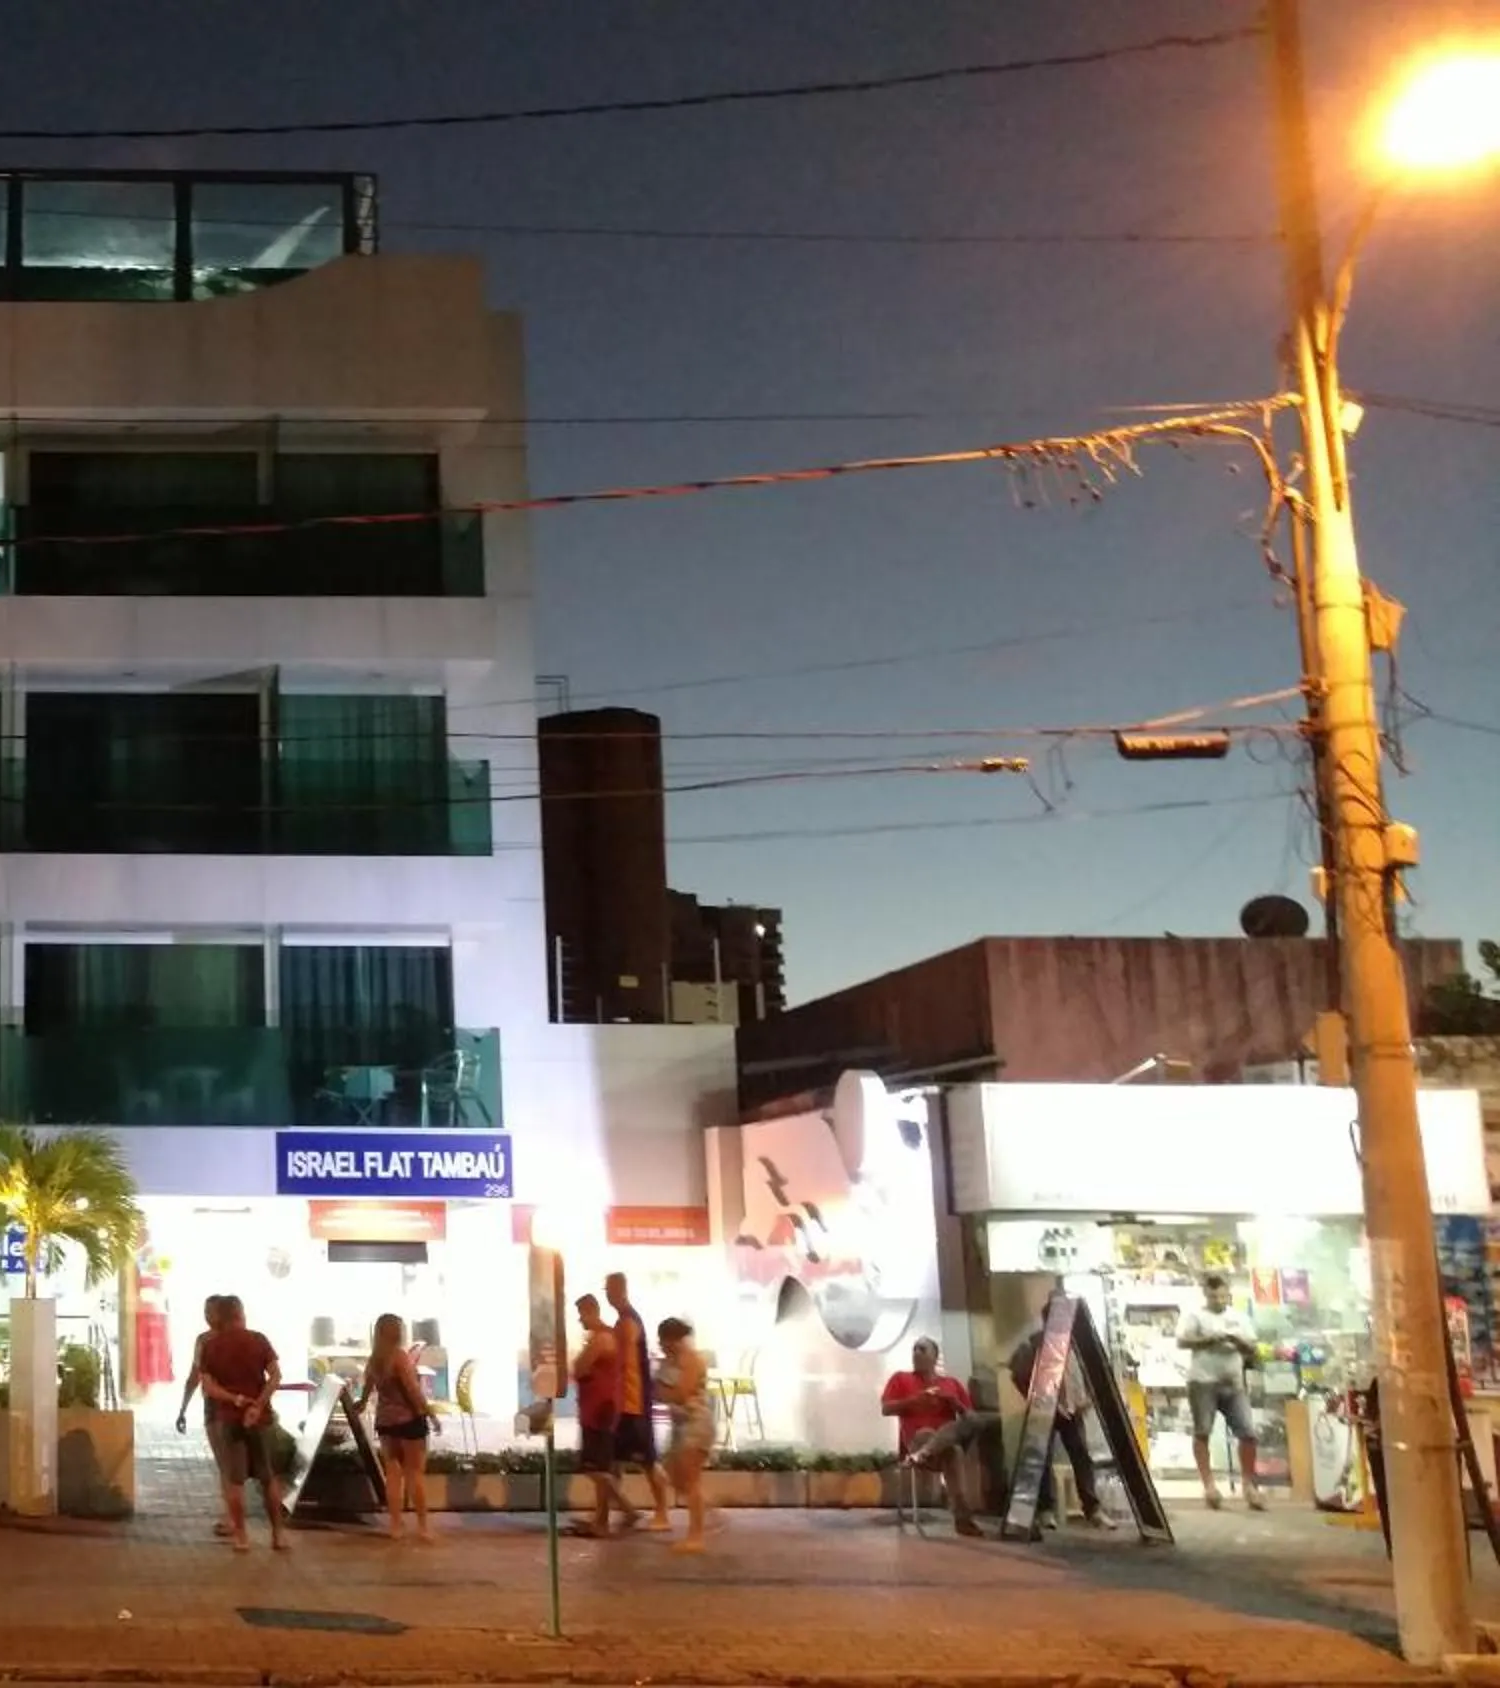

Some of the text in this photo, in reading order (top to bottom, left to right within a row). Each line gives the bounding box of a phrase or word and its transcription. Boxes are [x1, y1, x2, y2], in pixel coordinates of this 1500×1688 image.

[287, 1144, 505, 1179] ISRAEL FLAT TAMBAÚ
[484, 1184, 509, 1197] 296
